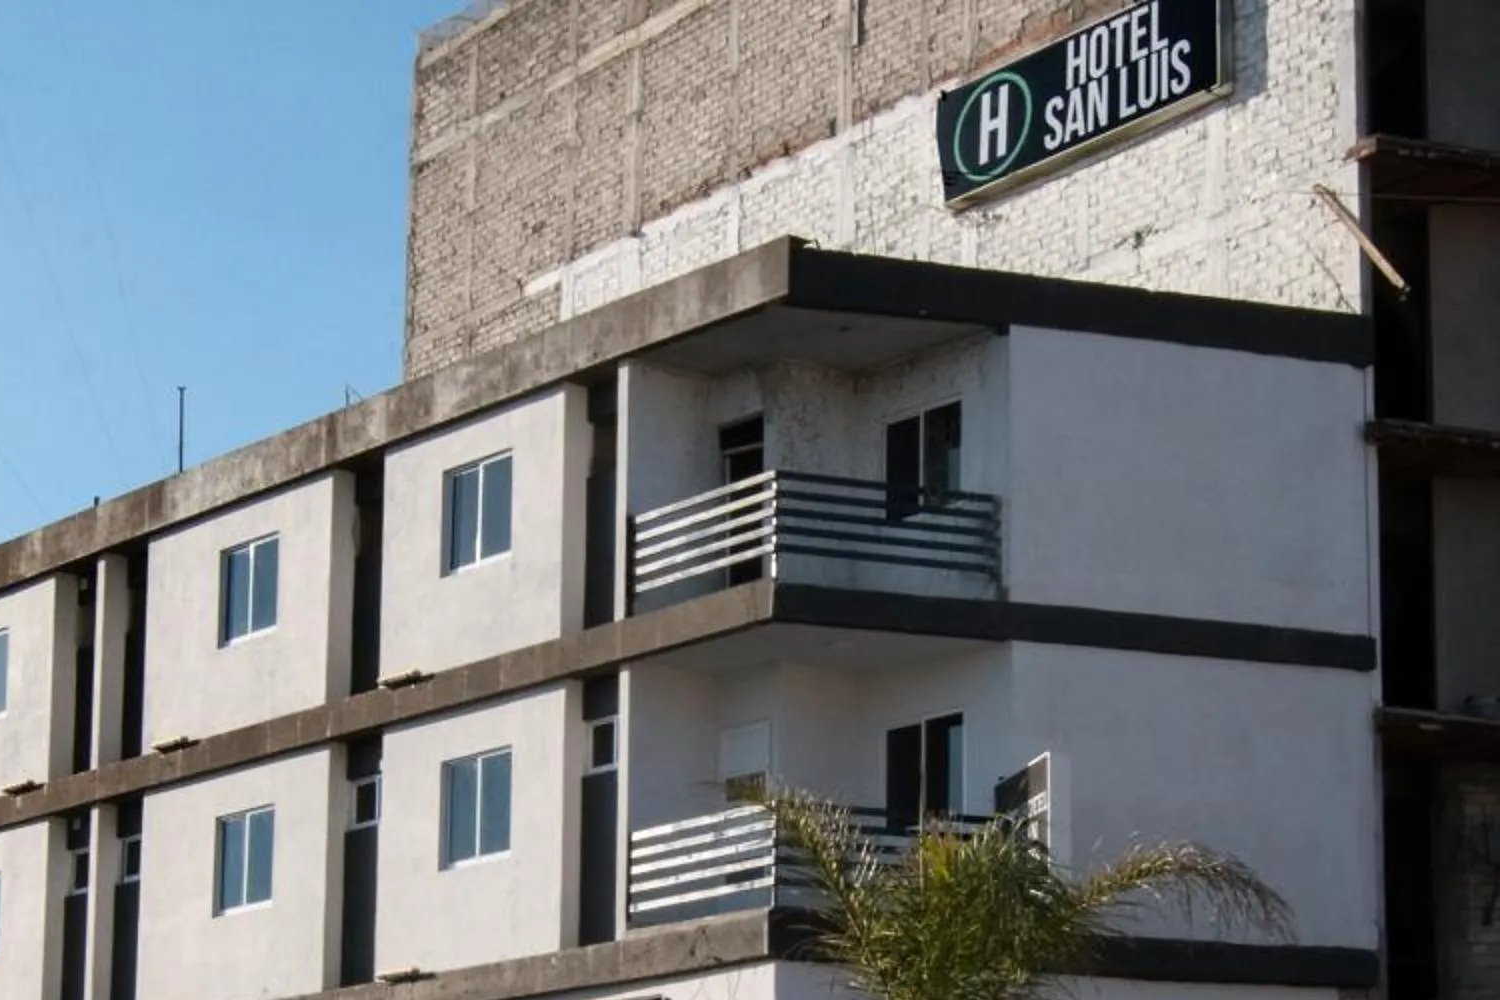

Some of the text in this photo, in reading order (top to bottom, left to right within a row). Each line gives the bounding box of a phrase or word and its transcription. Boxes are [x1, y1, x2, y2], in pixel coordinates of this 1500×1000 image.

[1065, 0, 1169, 91] HOTEL
[979, 83, 1010, 167] H
[1043, 40, 1192, 151] SAN LUIS
